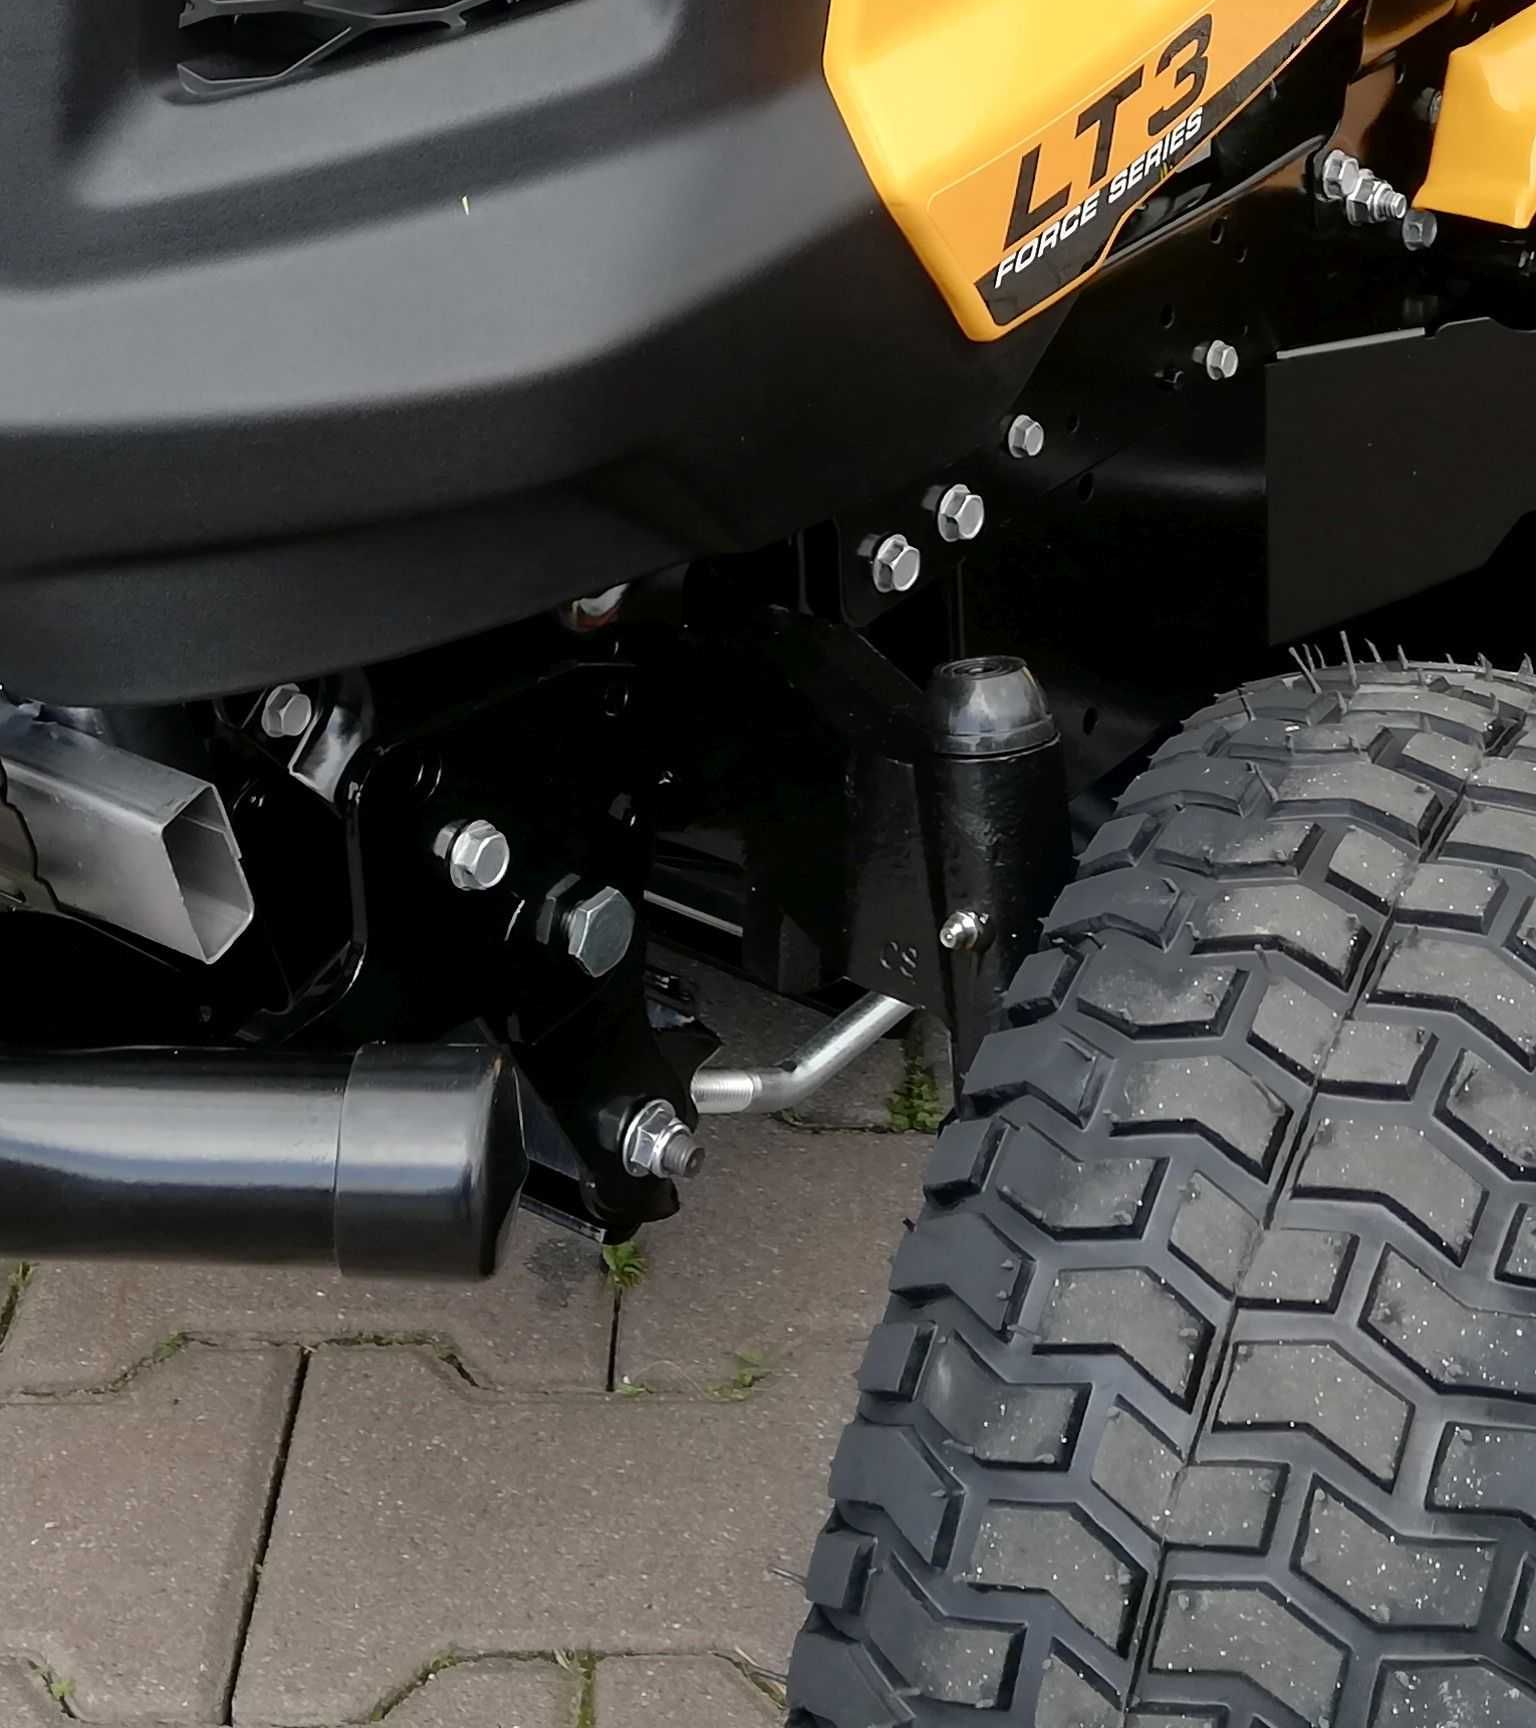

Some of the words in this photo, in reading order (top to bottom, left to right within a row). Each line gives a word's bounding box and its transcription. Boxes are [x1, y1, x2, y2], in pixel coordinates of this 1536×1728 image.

[994, 188, 1100, 290] FORCE
[1106, 106, 1205, 205] SERIES
[1003, 13, 1213, 252] LT3
